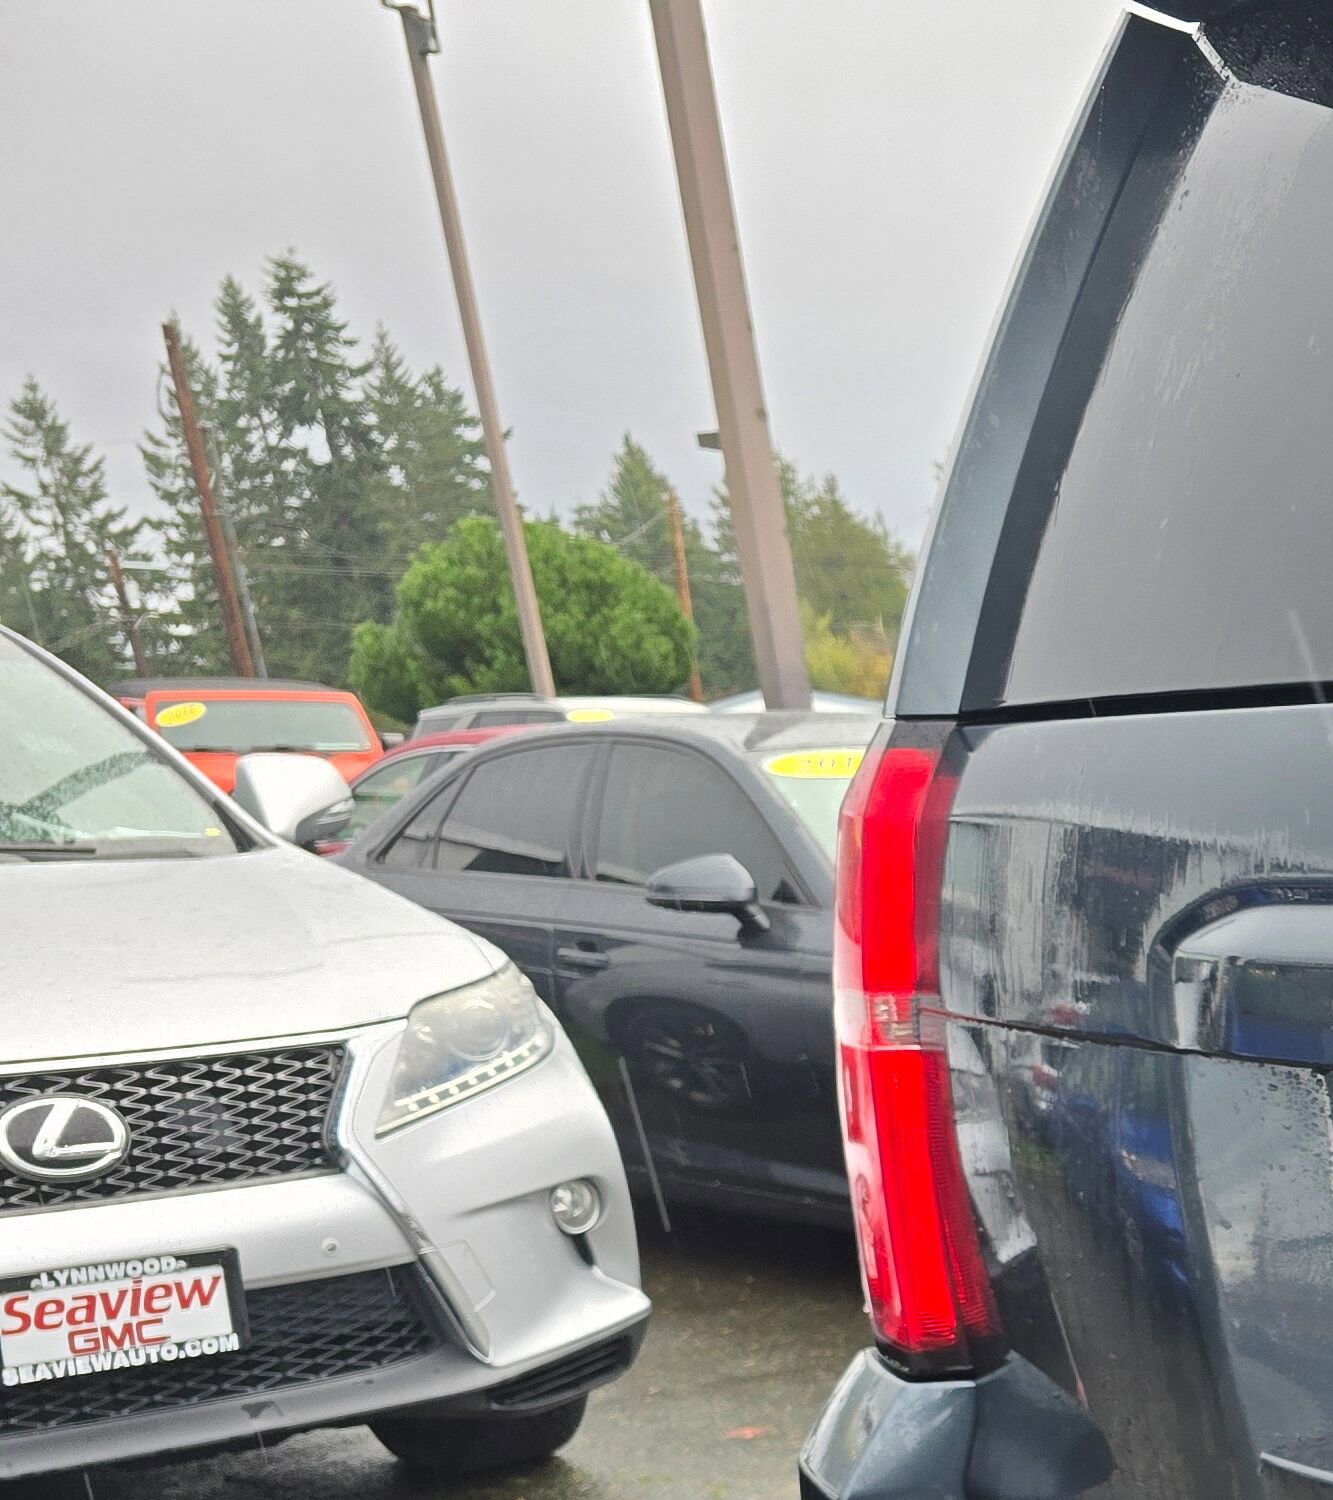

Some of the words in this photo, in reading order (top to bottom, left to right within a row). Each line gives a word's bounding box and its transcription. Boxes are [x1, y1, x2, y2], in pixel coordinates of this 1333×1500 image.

[40, 1256, 176, 1289] LYNNWOOD
[1, 1275, 222, 1336] Seaview
[1, 1332, 240, 1387] SEAVIEWAUTO.COM
[67, 1318, 171, 1355] GMC
